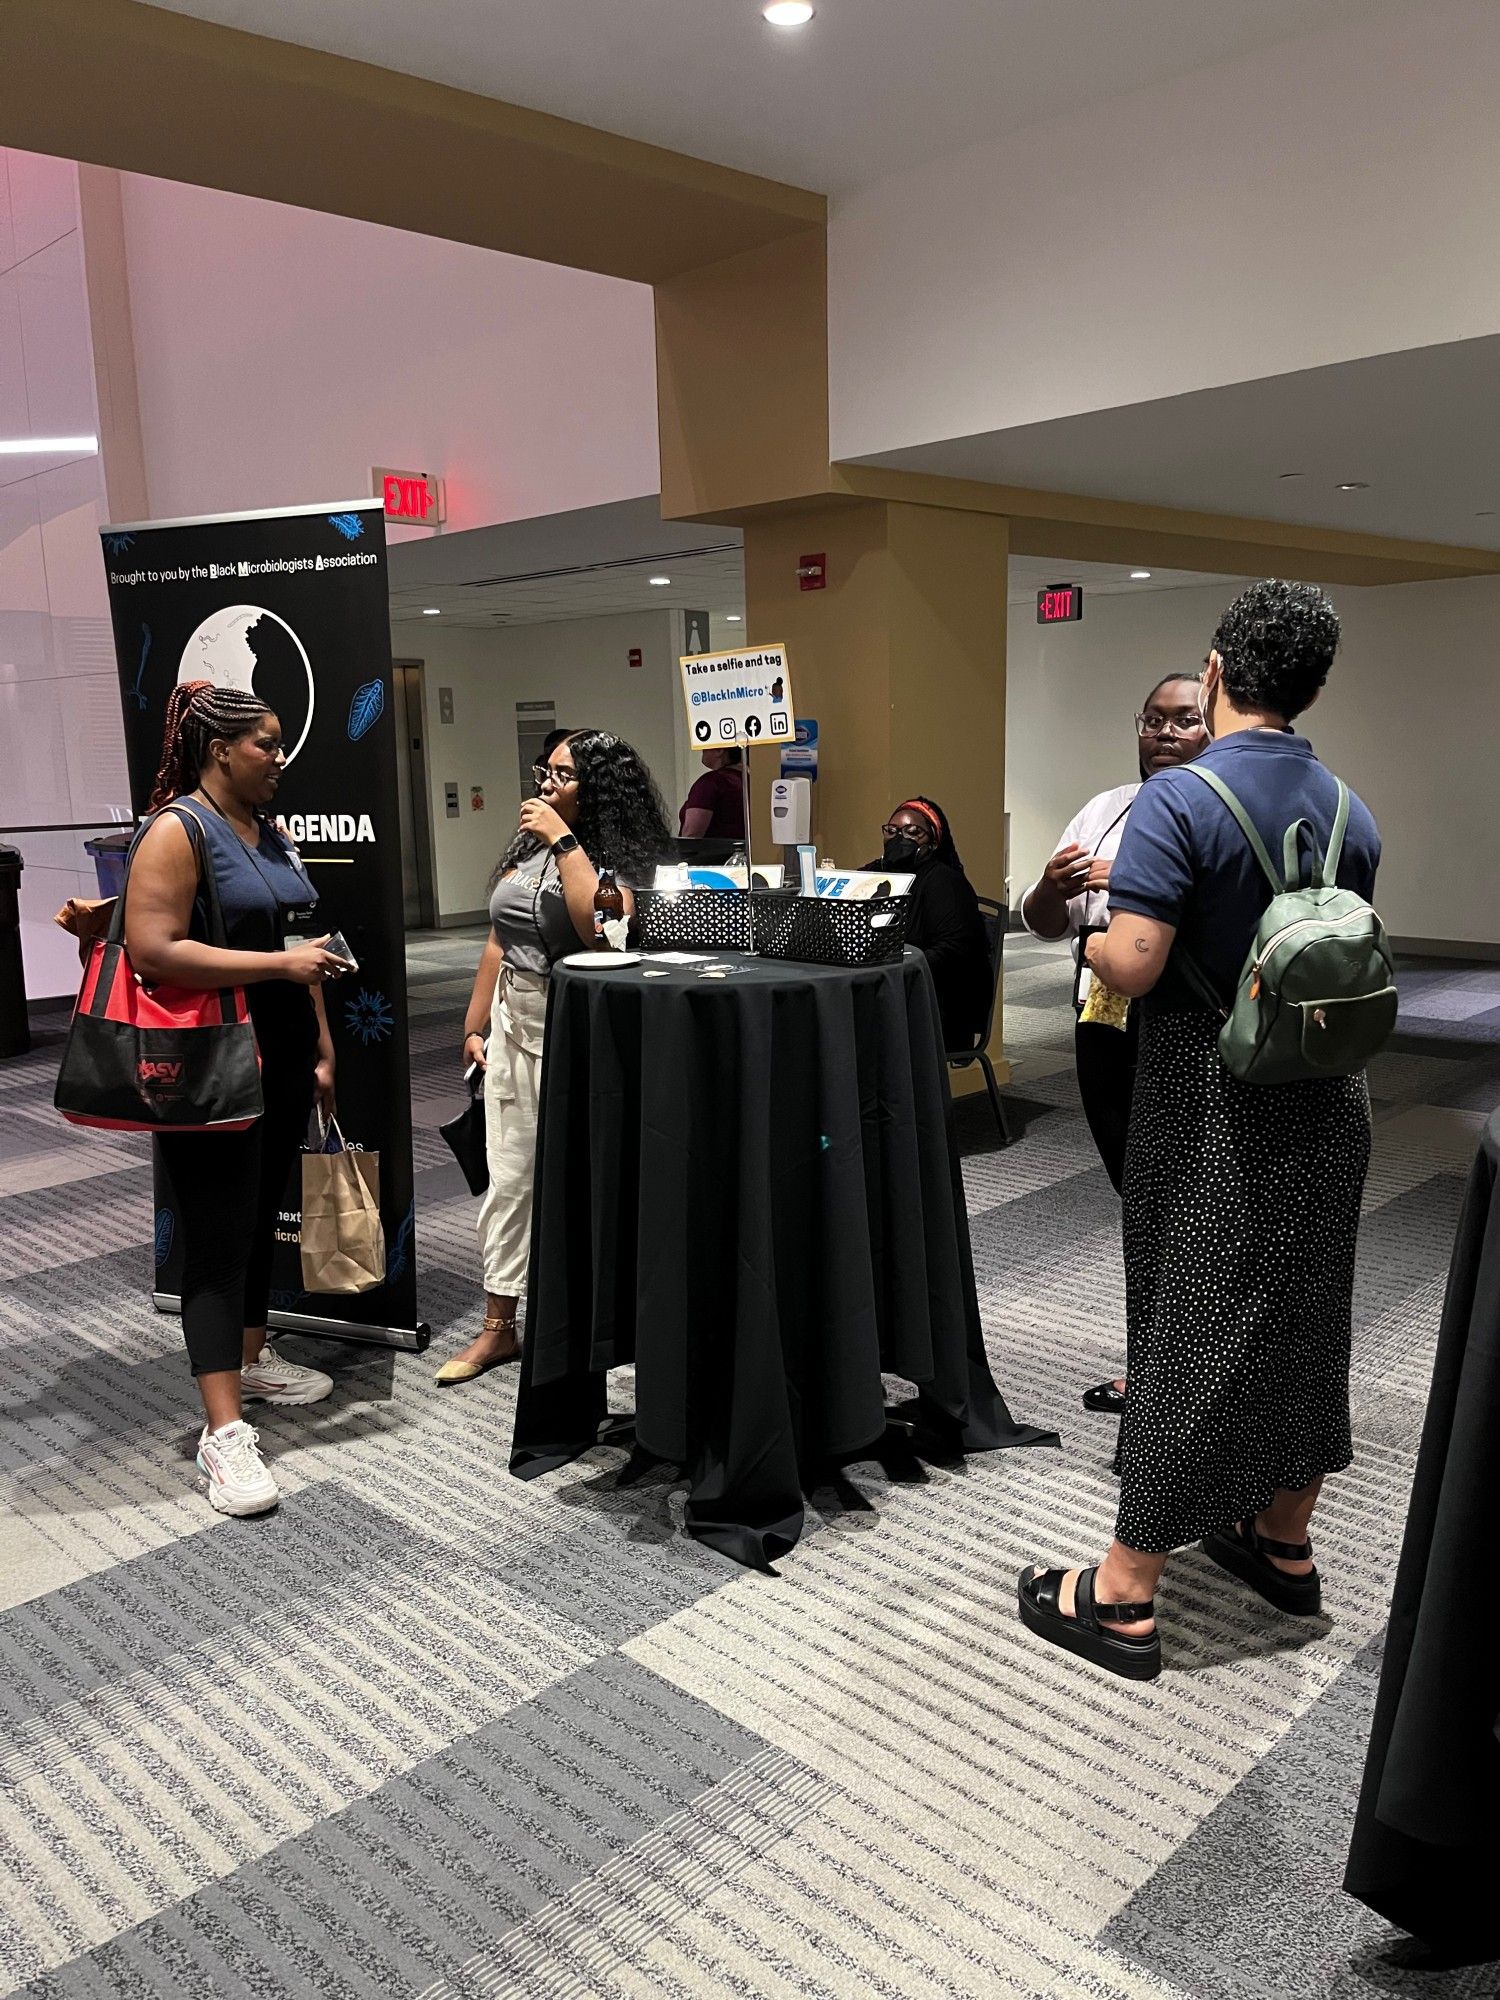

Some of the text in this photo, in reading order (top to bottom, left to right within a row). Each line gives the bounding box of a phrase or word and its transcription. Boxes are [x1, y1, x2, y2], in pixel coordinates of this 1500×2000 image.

[383, 475, 428, 518] EXIT
[111, 552, 377, 585] Brought to you by the Black Microbiologists Association
[1045, 591, 1072, 619] EXIT
[686, 654, 782, 675] Take a selfie and tag
[691, 686, 764, 706] @BlackInMicro
